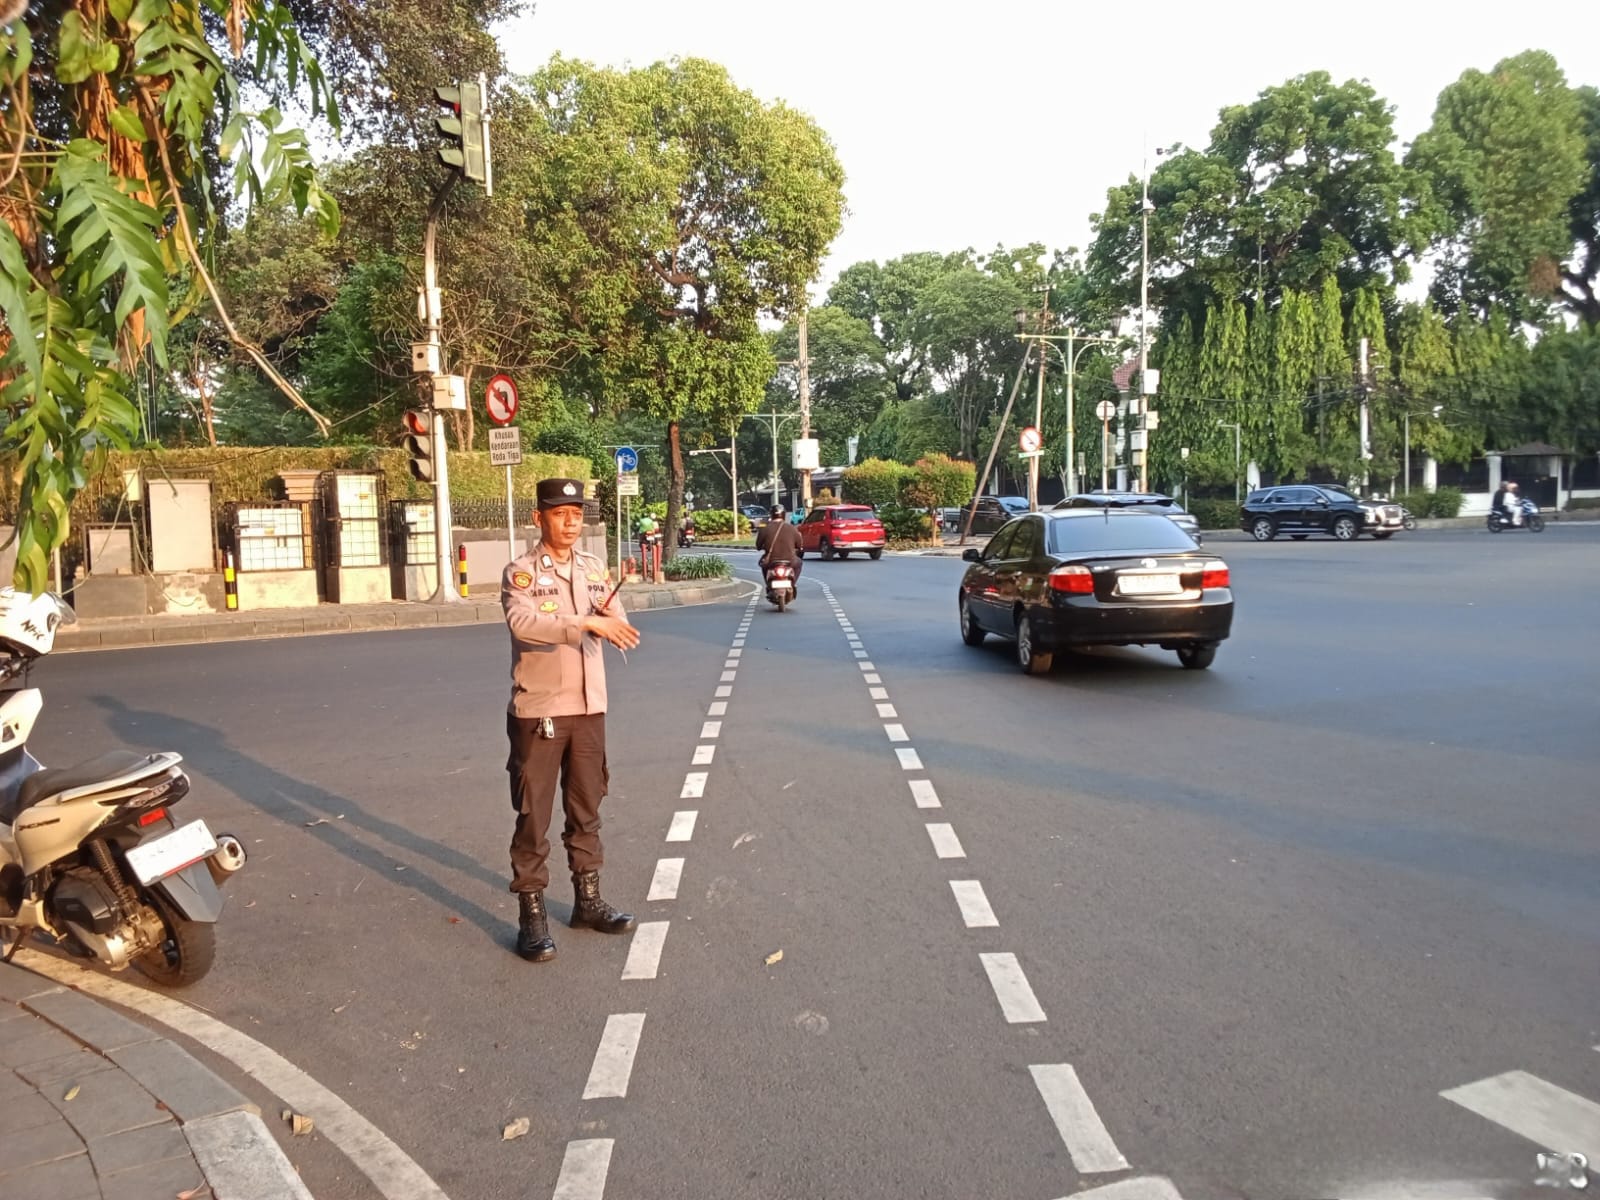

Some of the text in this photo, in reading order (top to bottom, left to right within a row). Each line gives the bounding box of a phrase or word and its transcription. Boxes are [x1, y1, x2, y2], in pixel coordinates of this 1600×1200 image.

[494, 431, 514, 440] Khusus
[491, 441, 519, 451] Kendaraan
[492, 450, 520, 462] Roda Tiga
